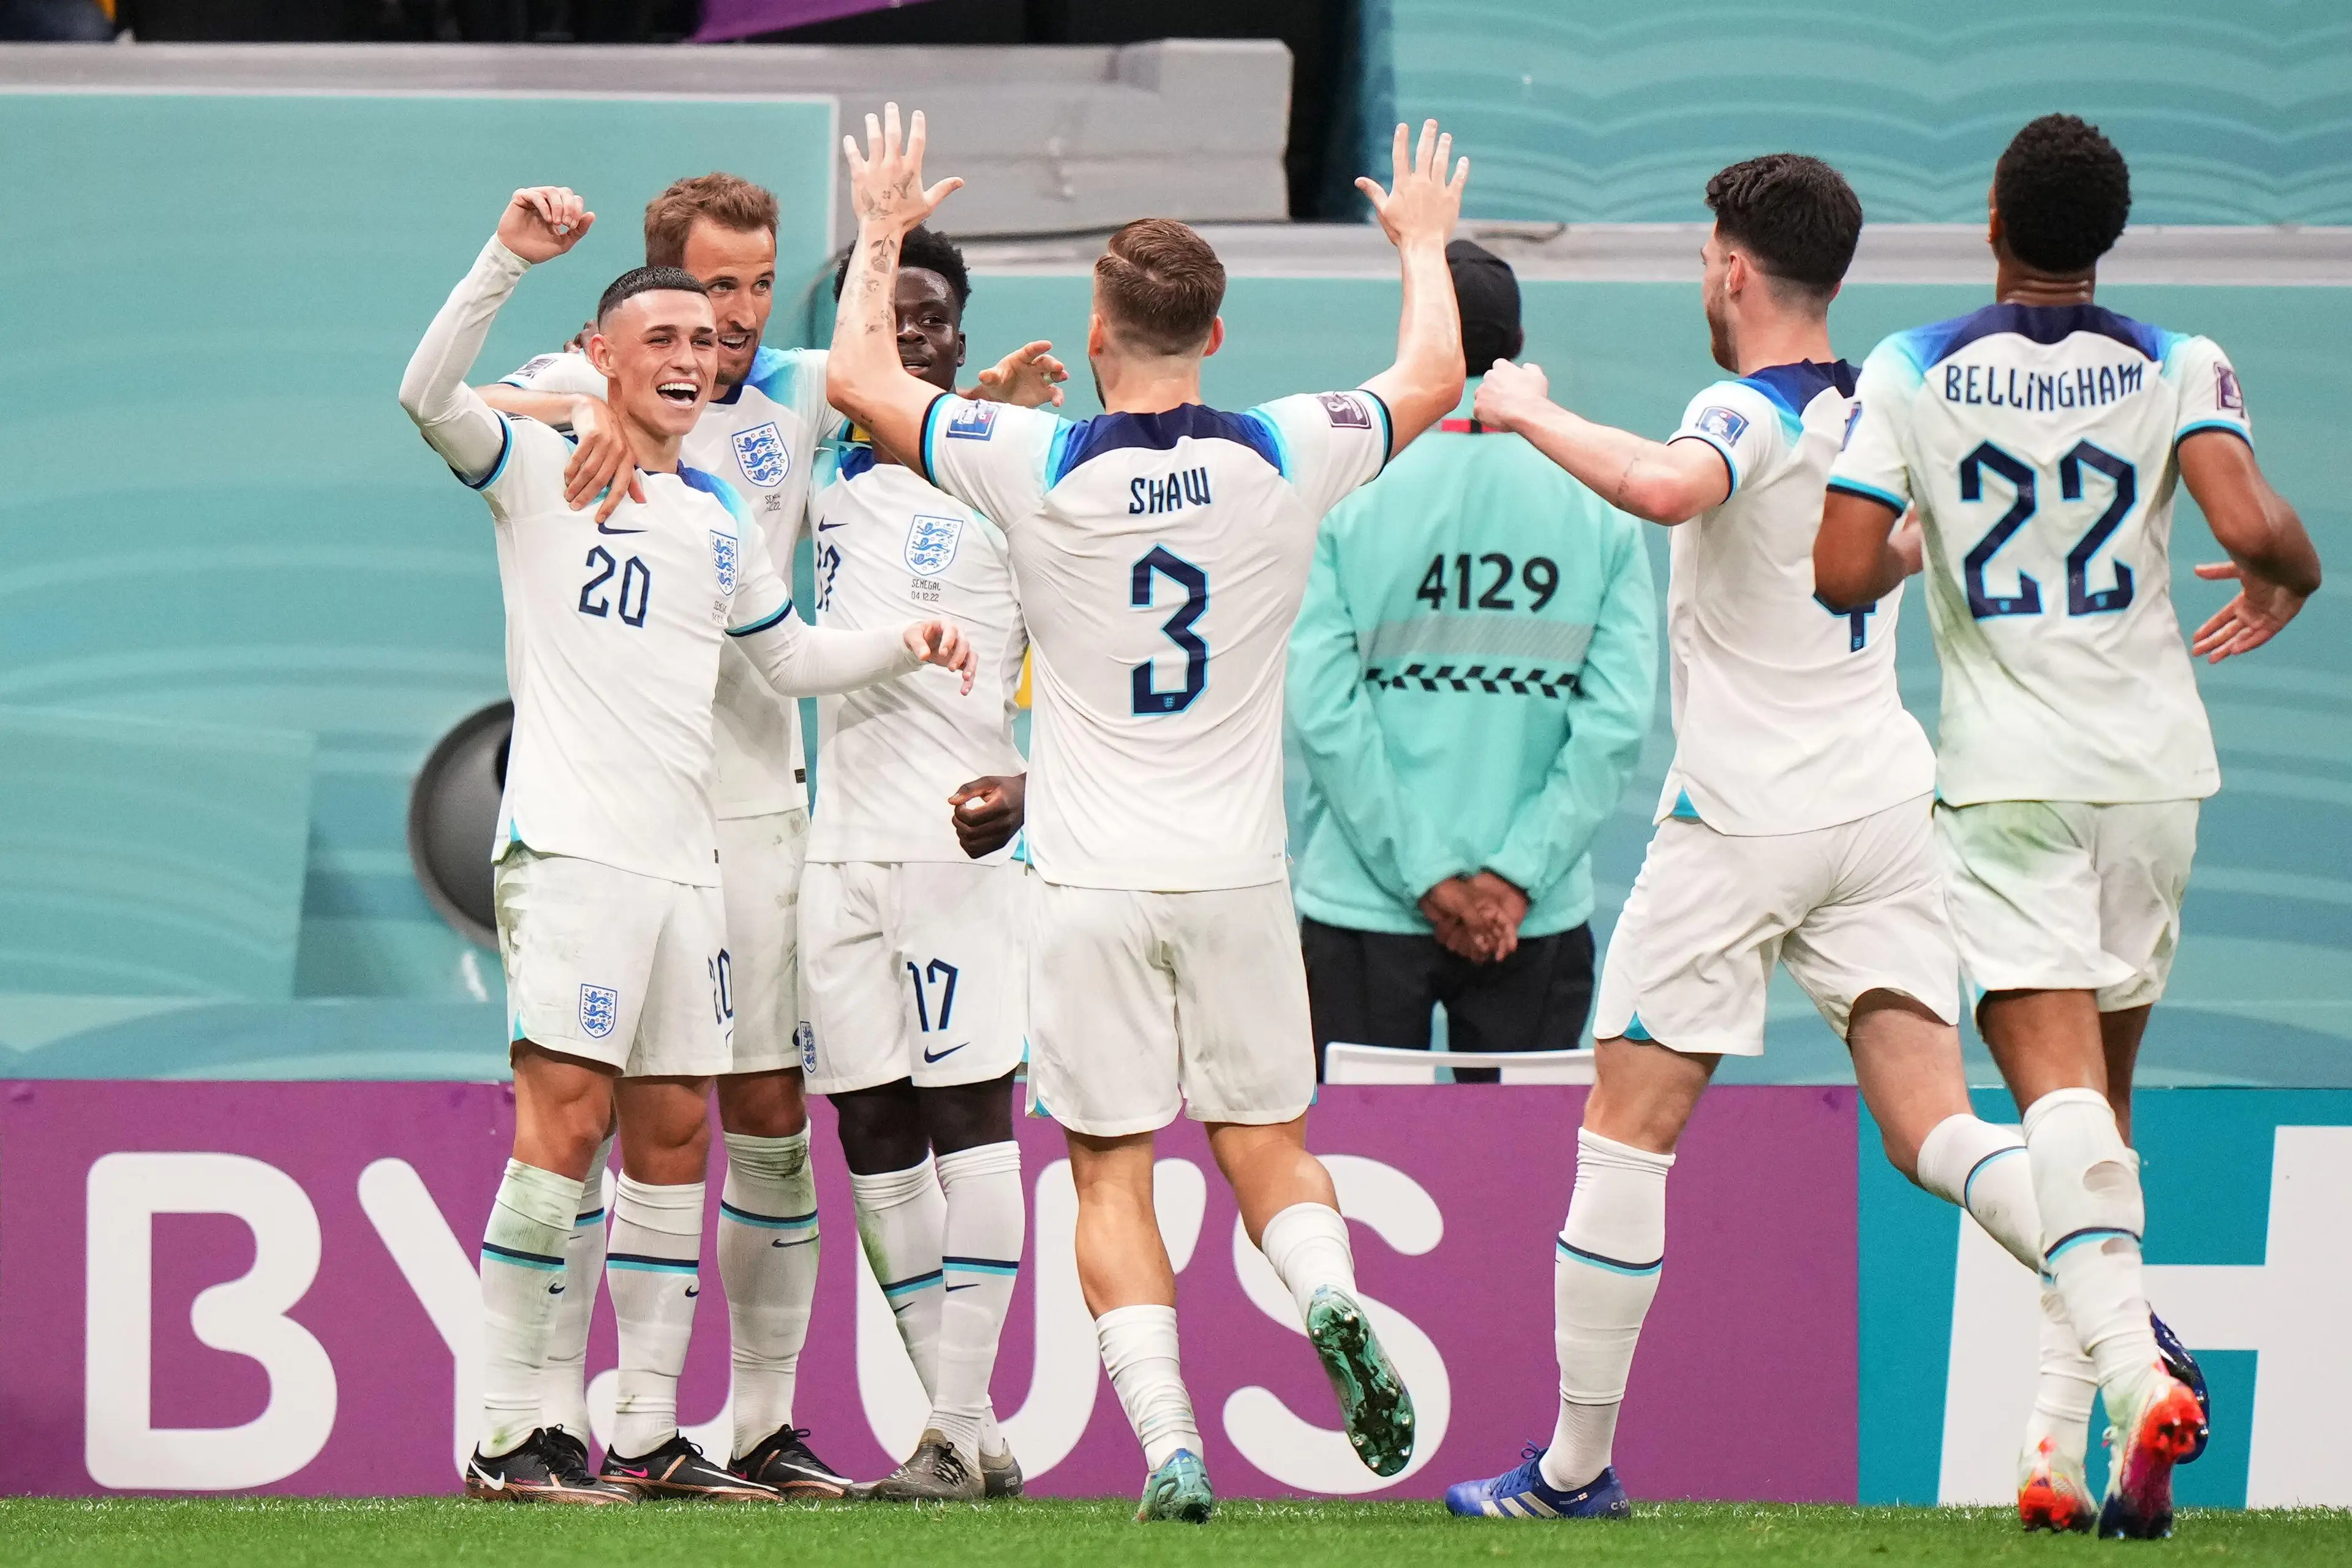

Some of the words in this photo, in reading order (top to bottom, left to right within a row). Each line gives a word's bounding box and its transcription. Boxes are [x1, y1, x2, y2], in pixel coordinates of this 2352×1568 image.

[1129, 467, 1212, 514] SHAW
[1958, 439, 2138, 622] 22
[579, 545, 650, 628] 20
[911, 579, 941, 591] SENEGAL
[911, 590, 940, 602] 04.12.22
[1416, 553, 1559, 613] 4129
[1130, 543, 1210, 717] 3
[907, 958, 959, 1033] 17
[85, 1153, 1451, 1494] BYU'S
